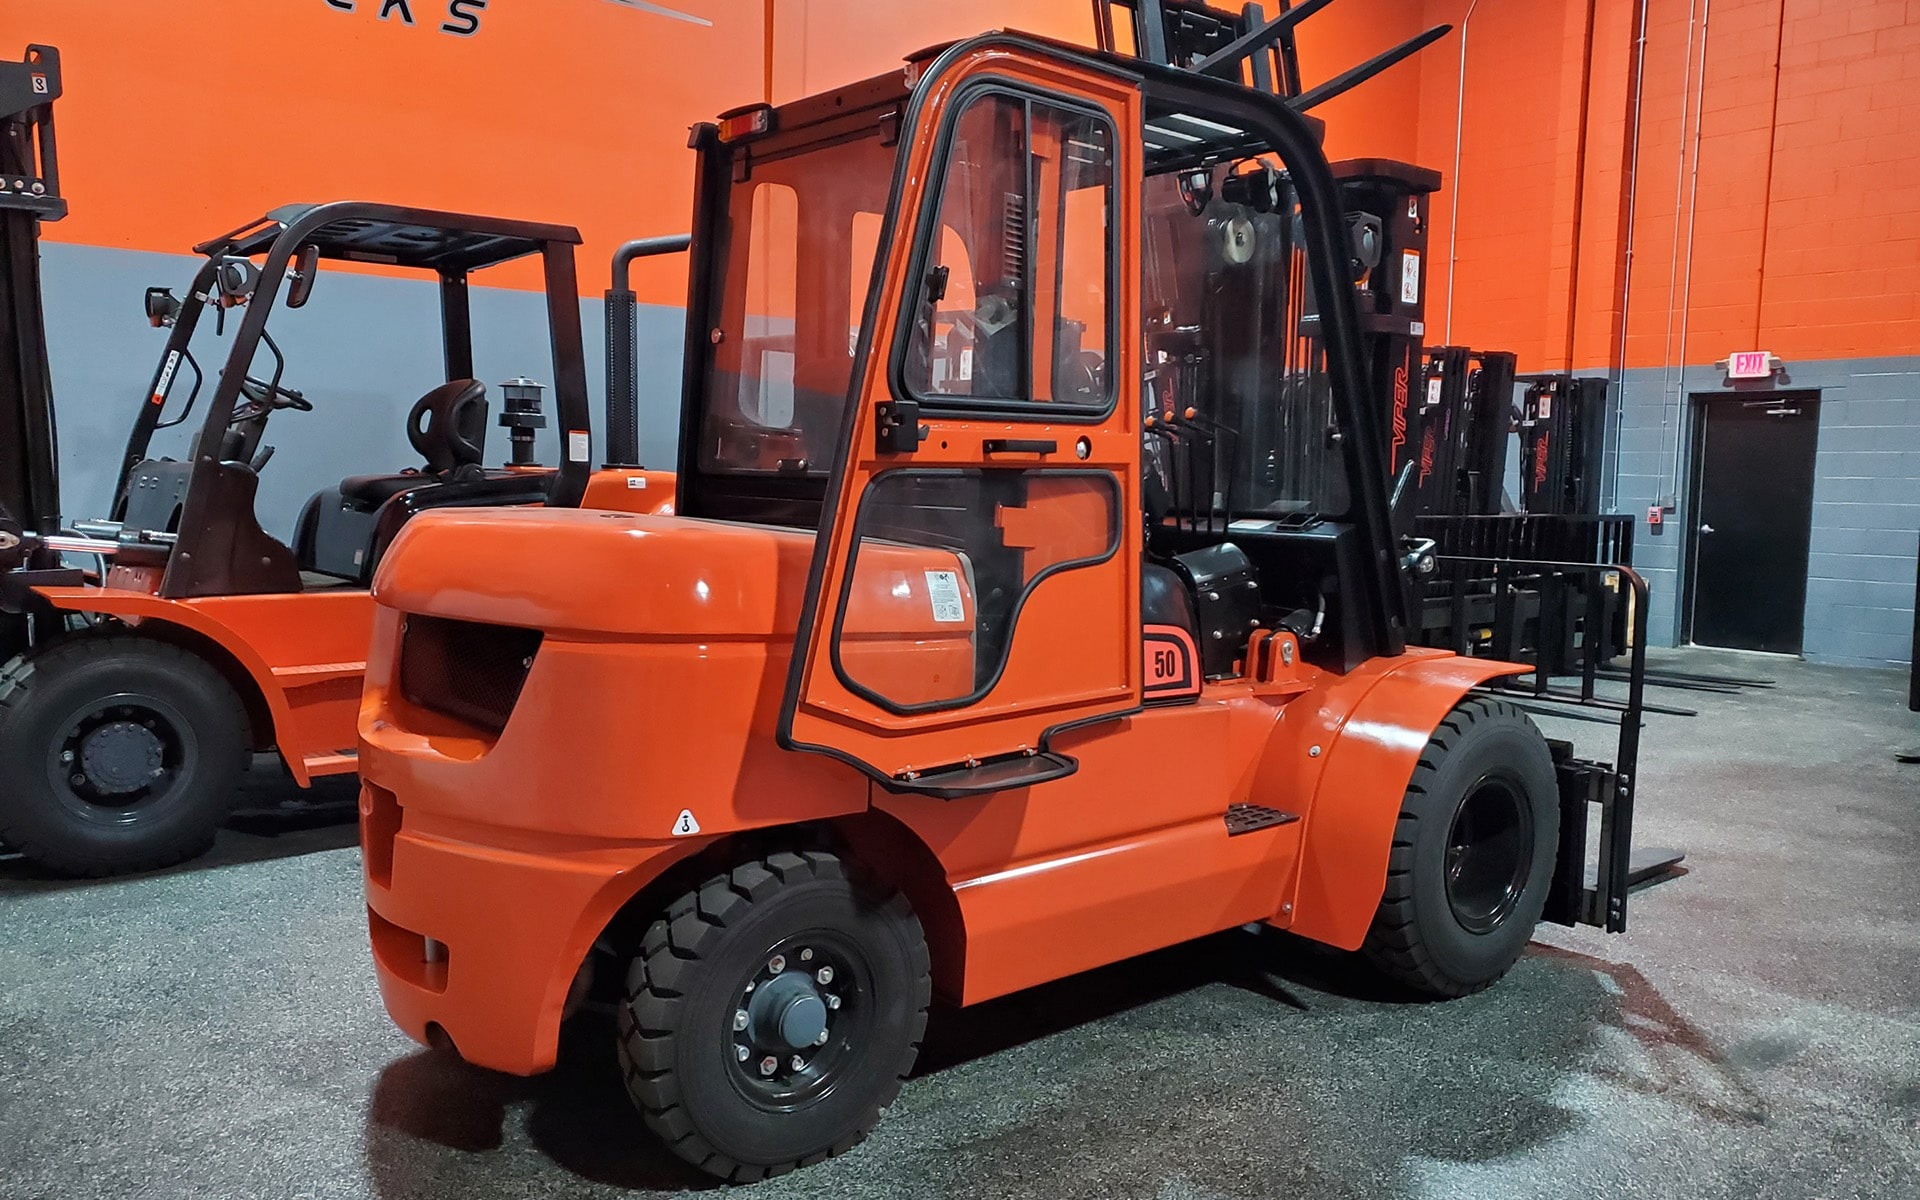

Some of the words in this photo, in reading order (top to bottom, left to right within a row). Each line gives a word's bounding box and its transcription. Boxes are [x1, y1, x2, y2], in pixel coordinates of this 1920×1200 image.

[1735, 353, 1765, 375] EXIT
[1391, 342, 1410, 476] VIPER
[1534, 430, 1549, 494] VIPER
[1154, 649, 1175, 679] 50
